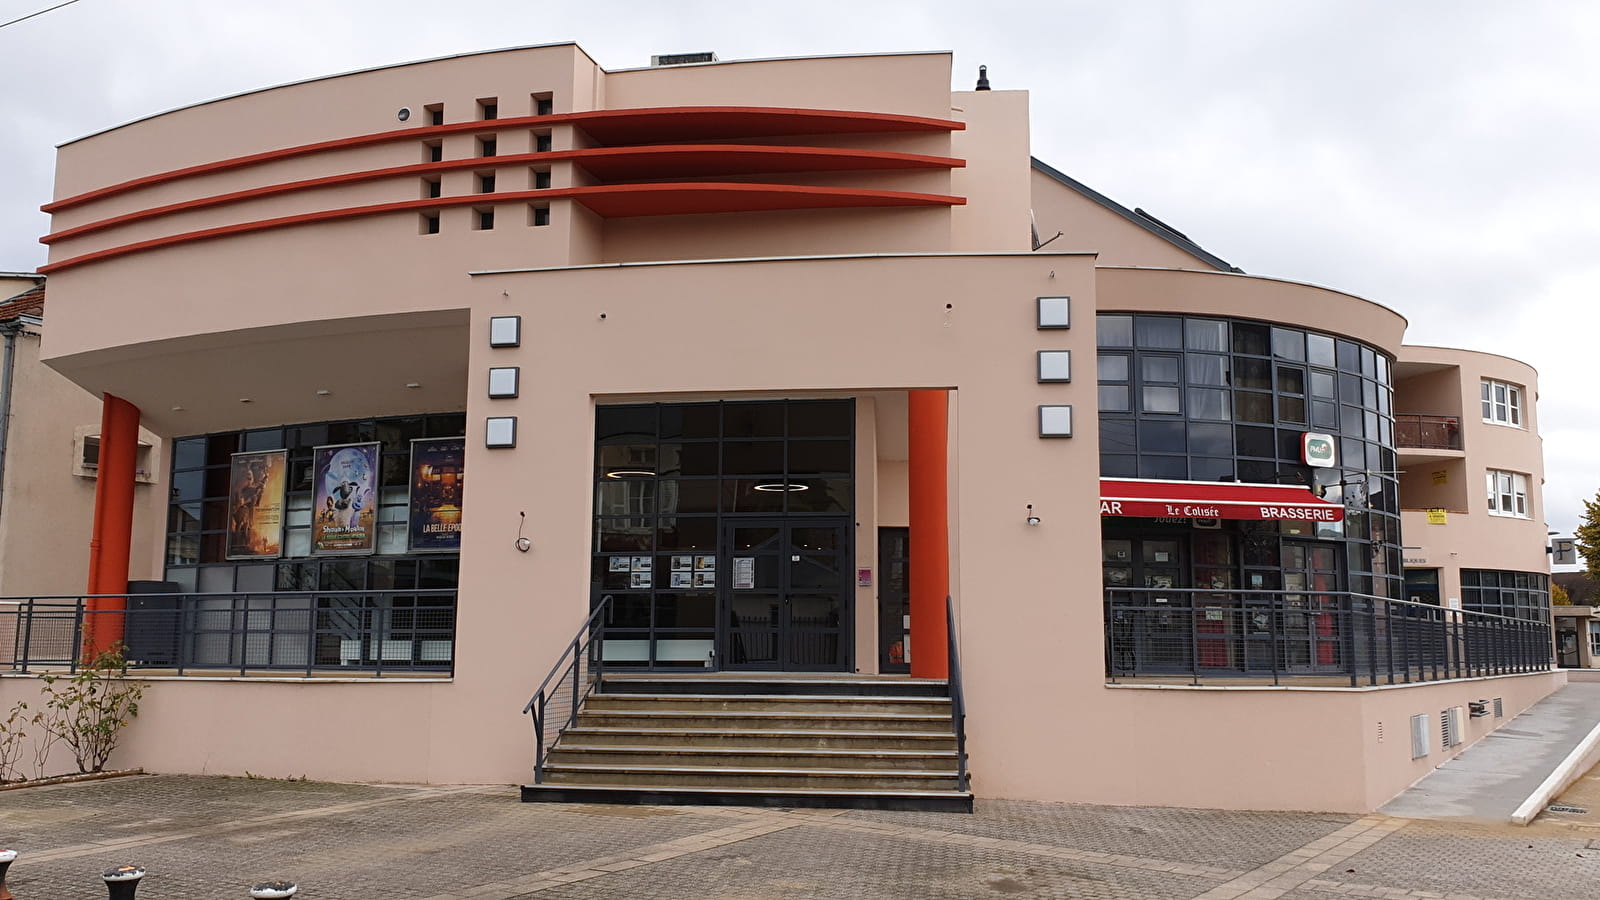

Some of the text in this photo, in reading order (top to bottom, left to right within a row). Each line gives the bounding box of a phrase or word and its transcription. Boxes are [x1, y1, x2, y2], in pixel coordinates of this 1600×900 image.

[1100, 501, 1123, 514] AR
[1165, 504, 1220, 517] Le Colisée
[1260, 507, 1335, 521] BRASSERIE
[423, 524, 430, 533] LA
[431, 523, 447, 533] BELLE
